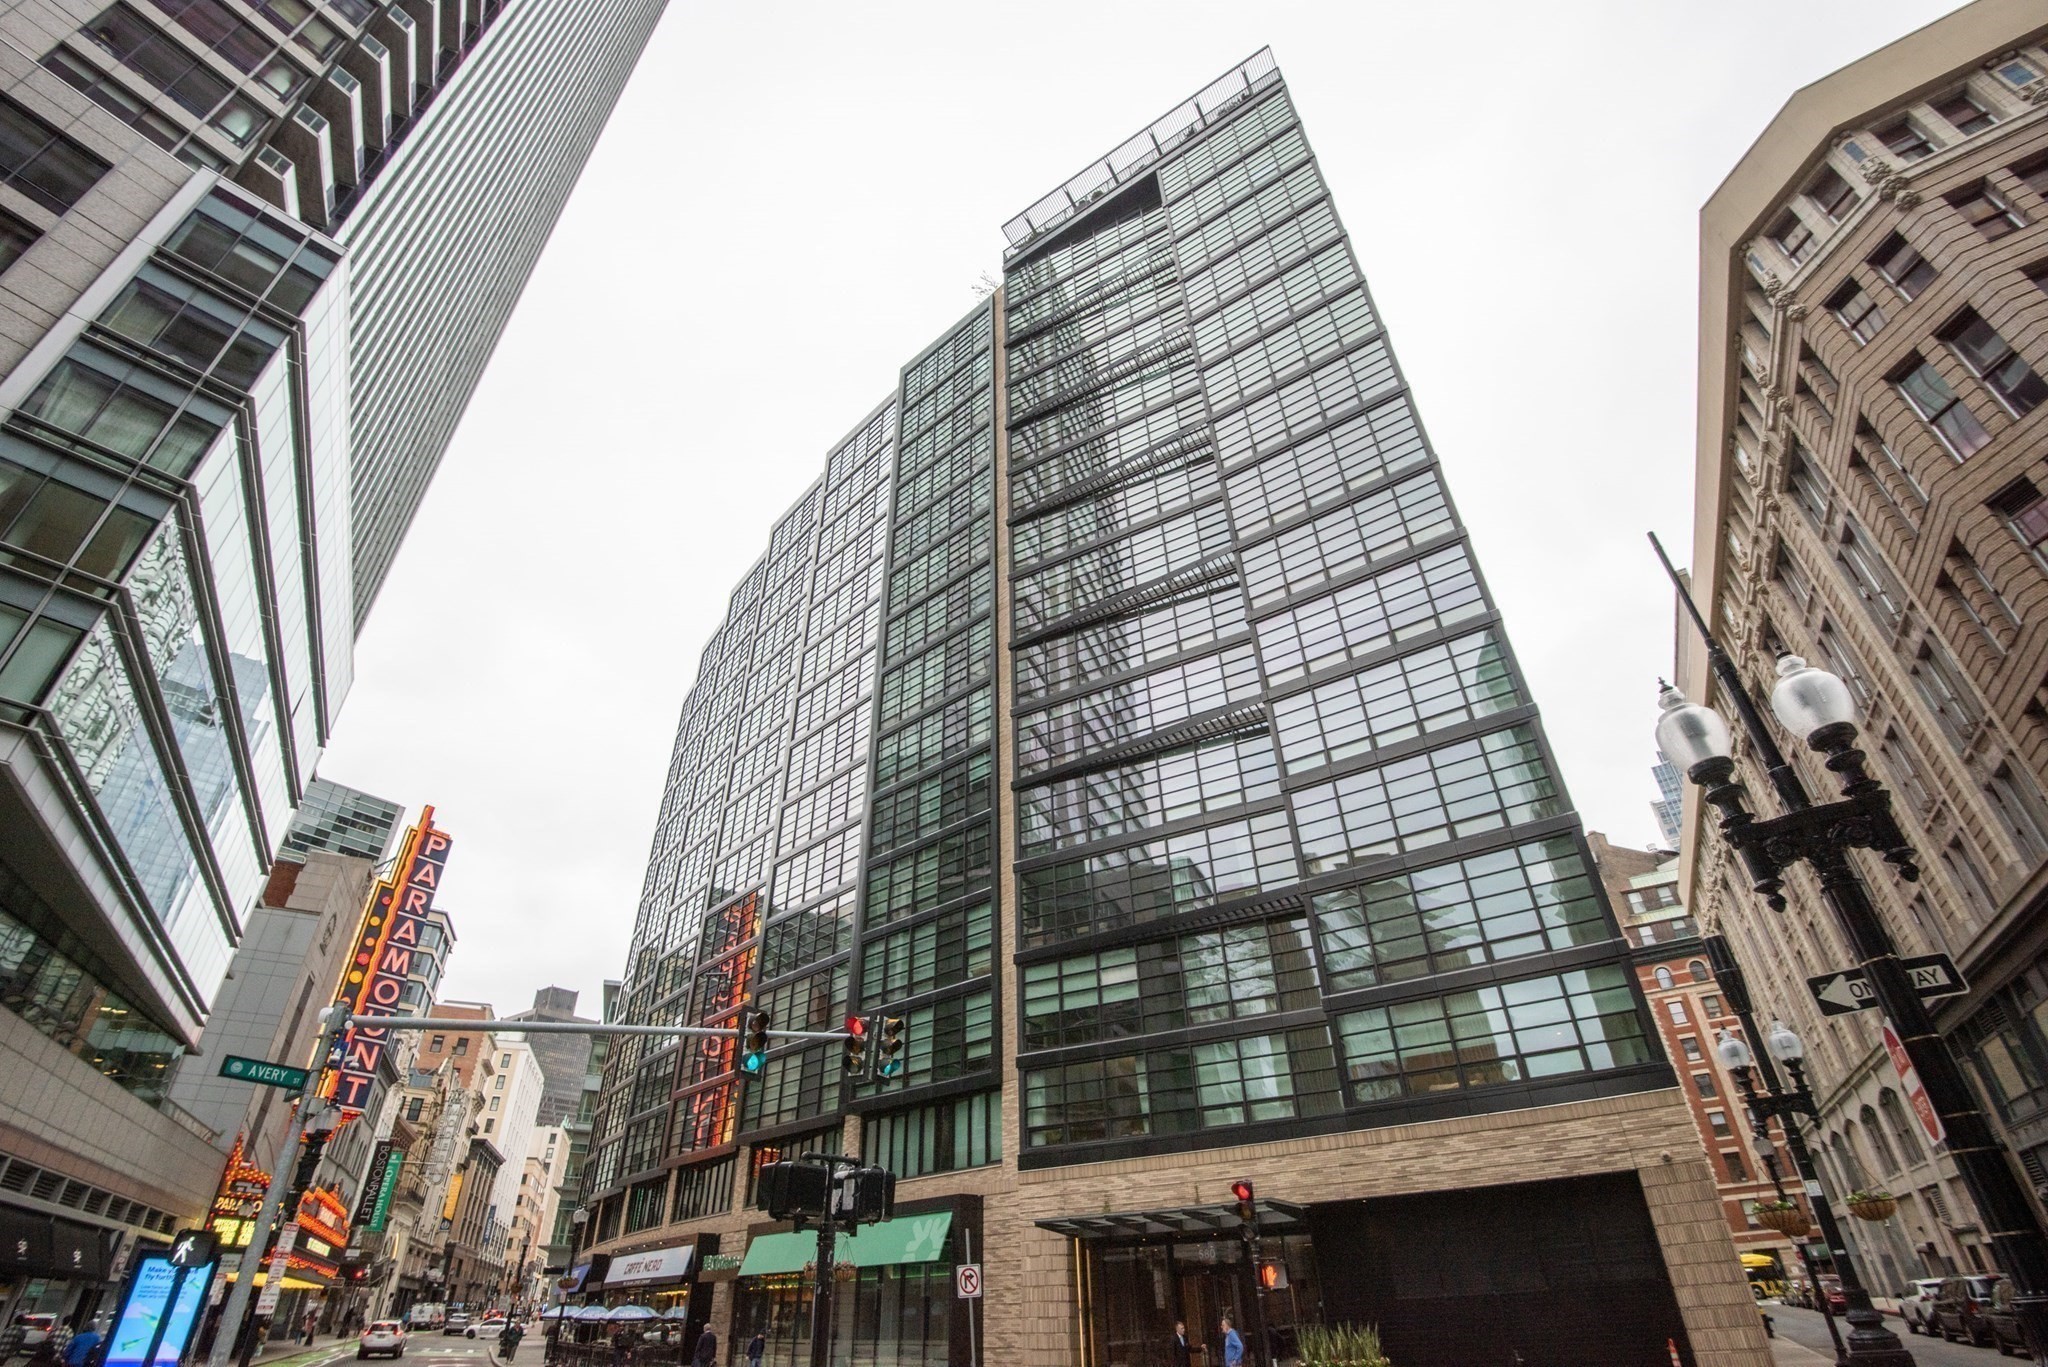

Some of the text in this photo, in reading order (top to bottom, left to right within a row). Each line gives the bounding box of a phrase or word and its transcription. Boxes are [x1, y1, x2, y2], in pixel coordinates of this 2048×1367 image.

[346, 835, 447, 1104] PARAMOUNT
[1911, 968, 1940, 988] AY
[248, 1065, 288, 1082] AVERY
[370, 1169, 394, 1228] OPERA HOUSE
[1199, 1249, 1216, 1259] 580
[643, 1259, 663, 1272] NERO
